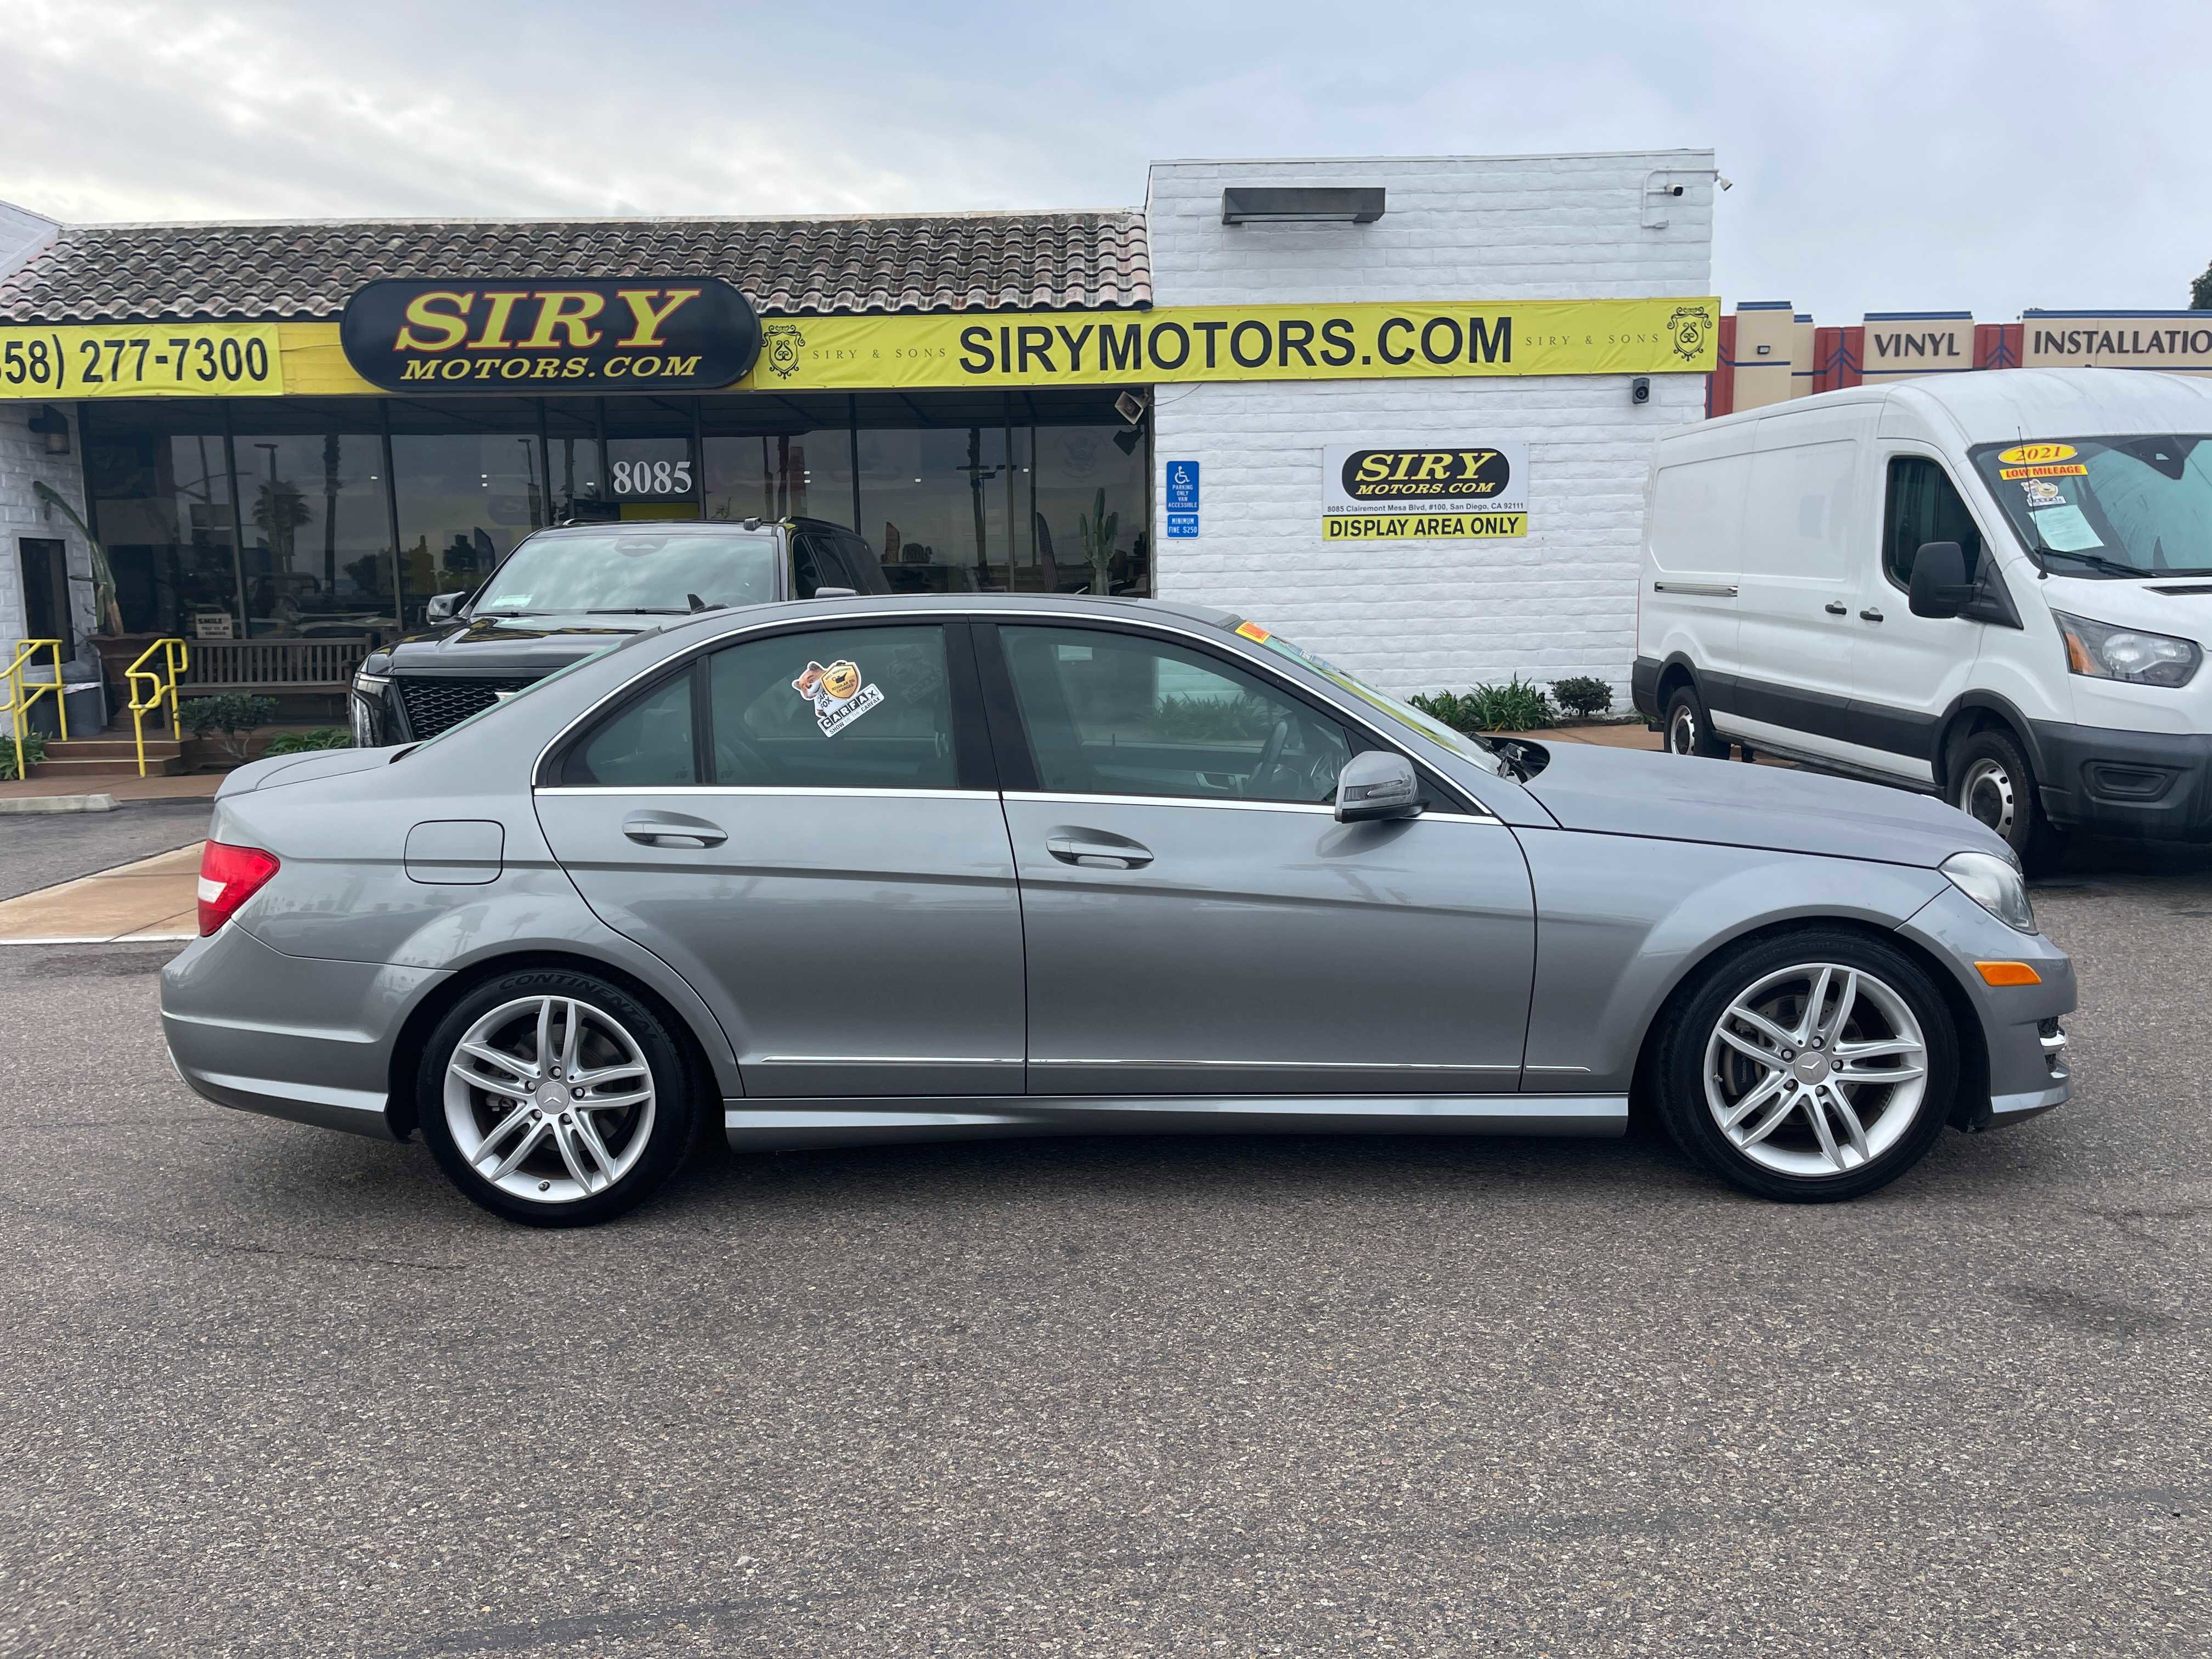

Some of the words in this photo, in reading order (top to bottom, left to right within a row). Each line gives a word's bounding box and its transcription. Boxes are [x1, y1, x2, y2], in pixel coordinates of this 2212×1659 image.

[393, 288, 702, 352] SIRY
[959, 315, 1512, 374] SIRYMOTORS.COM
[1526, 335, 1570, 346] SIRY
[1585, 335, 1593, 345] &
[1609, 334, 1658, 344] SONS
[1874, 332, 1960, 357] VINYL
[2034, 329, 2212, 355] INSTALLATIO
[0, 334, 64, 390] 58)
[80, 337, 268, 383] 277-7300
[812, 349, 857, 359] SIRY
[872, 349, 880, 358] &
[895, 348, 945, 358] SONS
[399, 355, 702, 381] MOTORS.COM
[2015, 446, 2061, 461] 2021
[612, 460, 692, 494] 8085
[1355, 452, 1497, 482] SIRY
[2006, 467, 2029, 478] LOW
[2033, 466, 2081, 477] MILEAGE
[1355, 482, 1496, 495] MOTORS.COM
[1466, 503, 1489, 511] Diego,
[1330, 518, 1410, 537] DISPLAY
[1414, 518, 1465, 536] AREA
[1470, 517, 1519, 534] ONLY
[821, 696, 833, 709] FOX
[821, 689, 876, 729] CARFAX
[830, 721, 844, 734] SHOW
[861, 696, 881, 712] CARFAX
